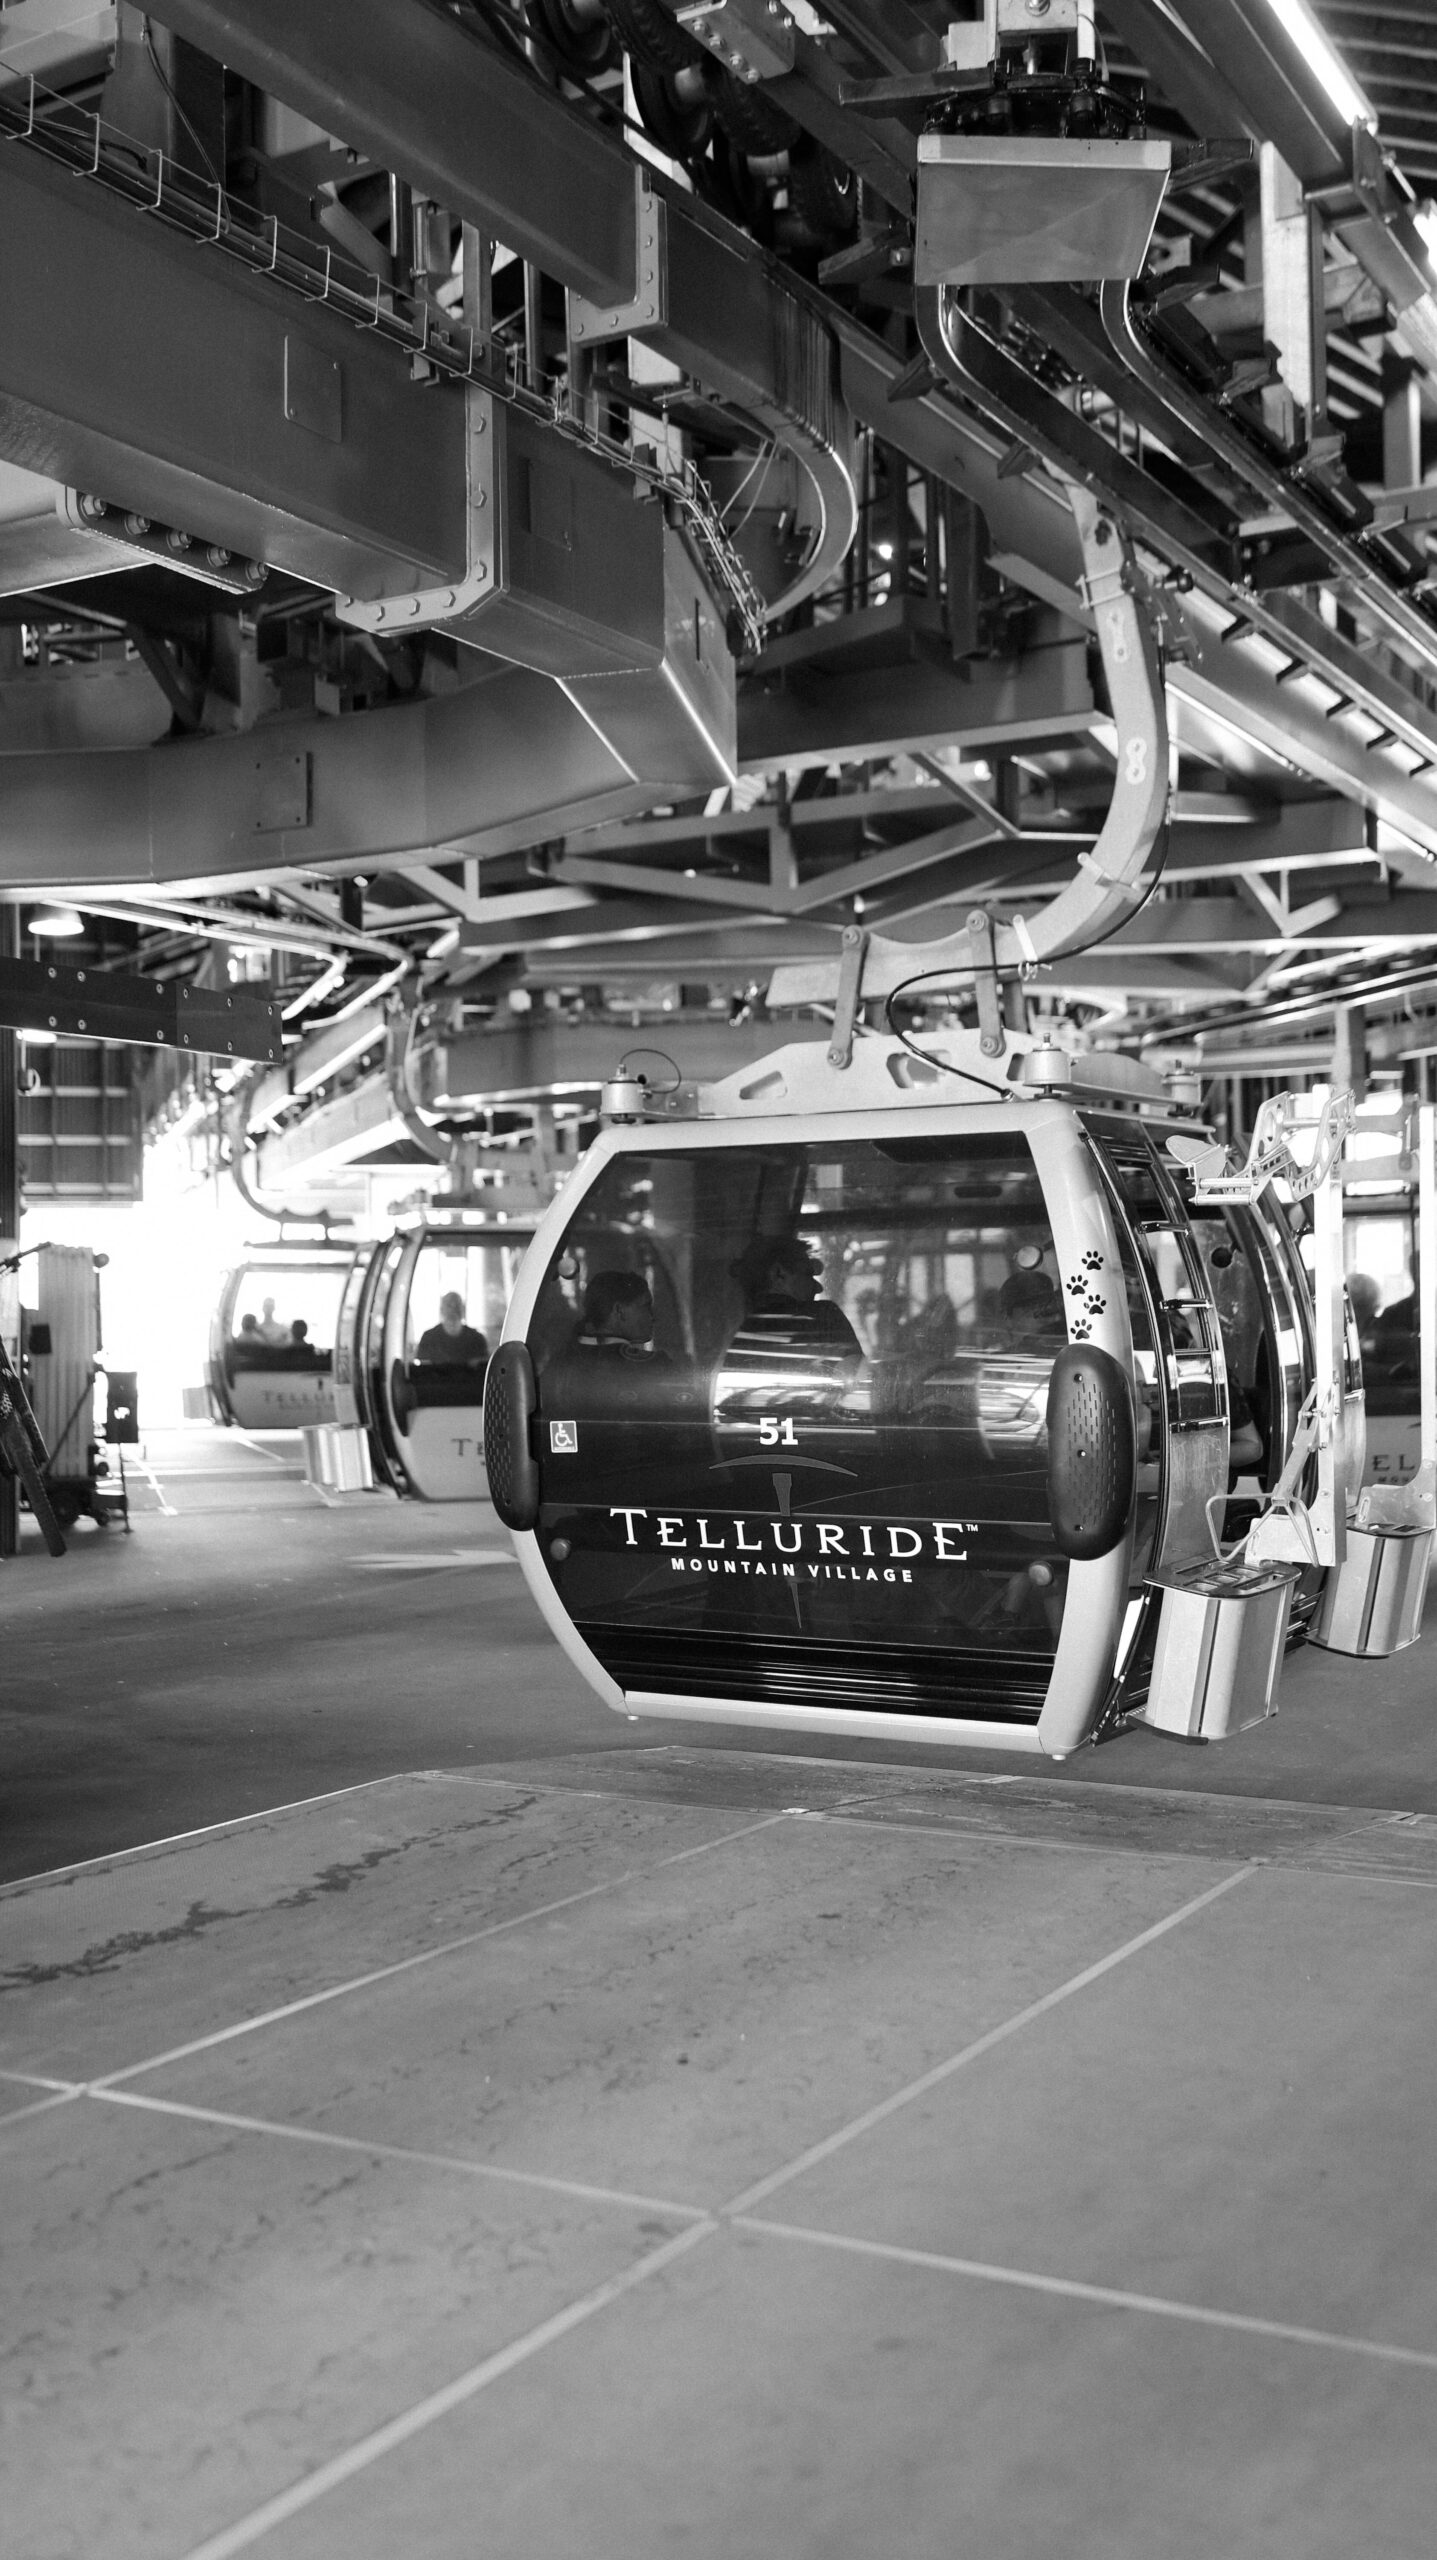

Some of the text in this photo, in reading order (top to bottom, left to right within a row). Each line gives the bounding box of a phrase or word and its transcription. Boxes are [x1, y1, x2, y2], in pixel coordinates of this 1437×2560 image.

[759, 1417, 798, 1445] 51
[670, 1557, 913, 1583] MOUNTAIN VILLAGE
